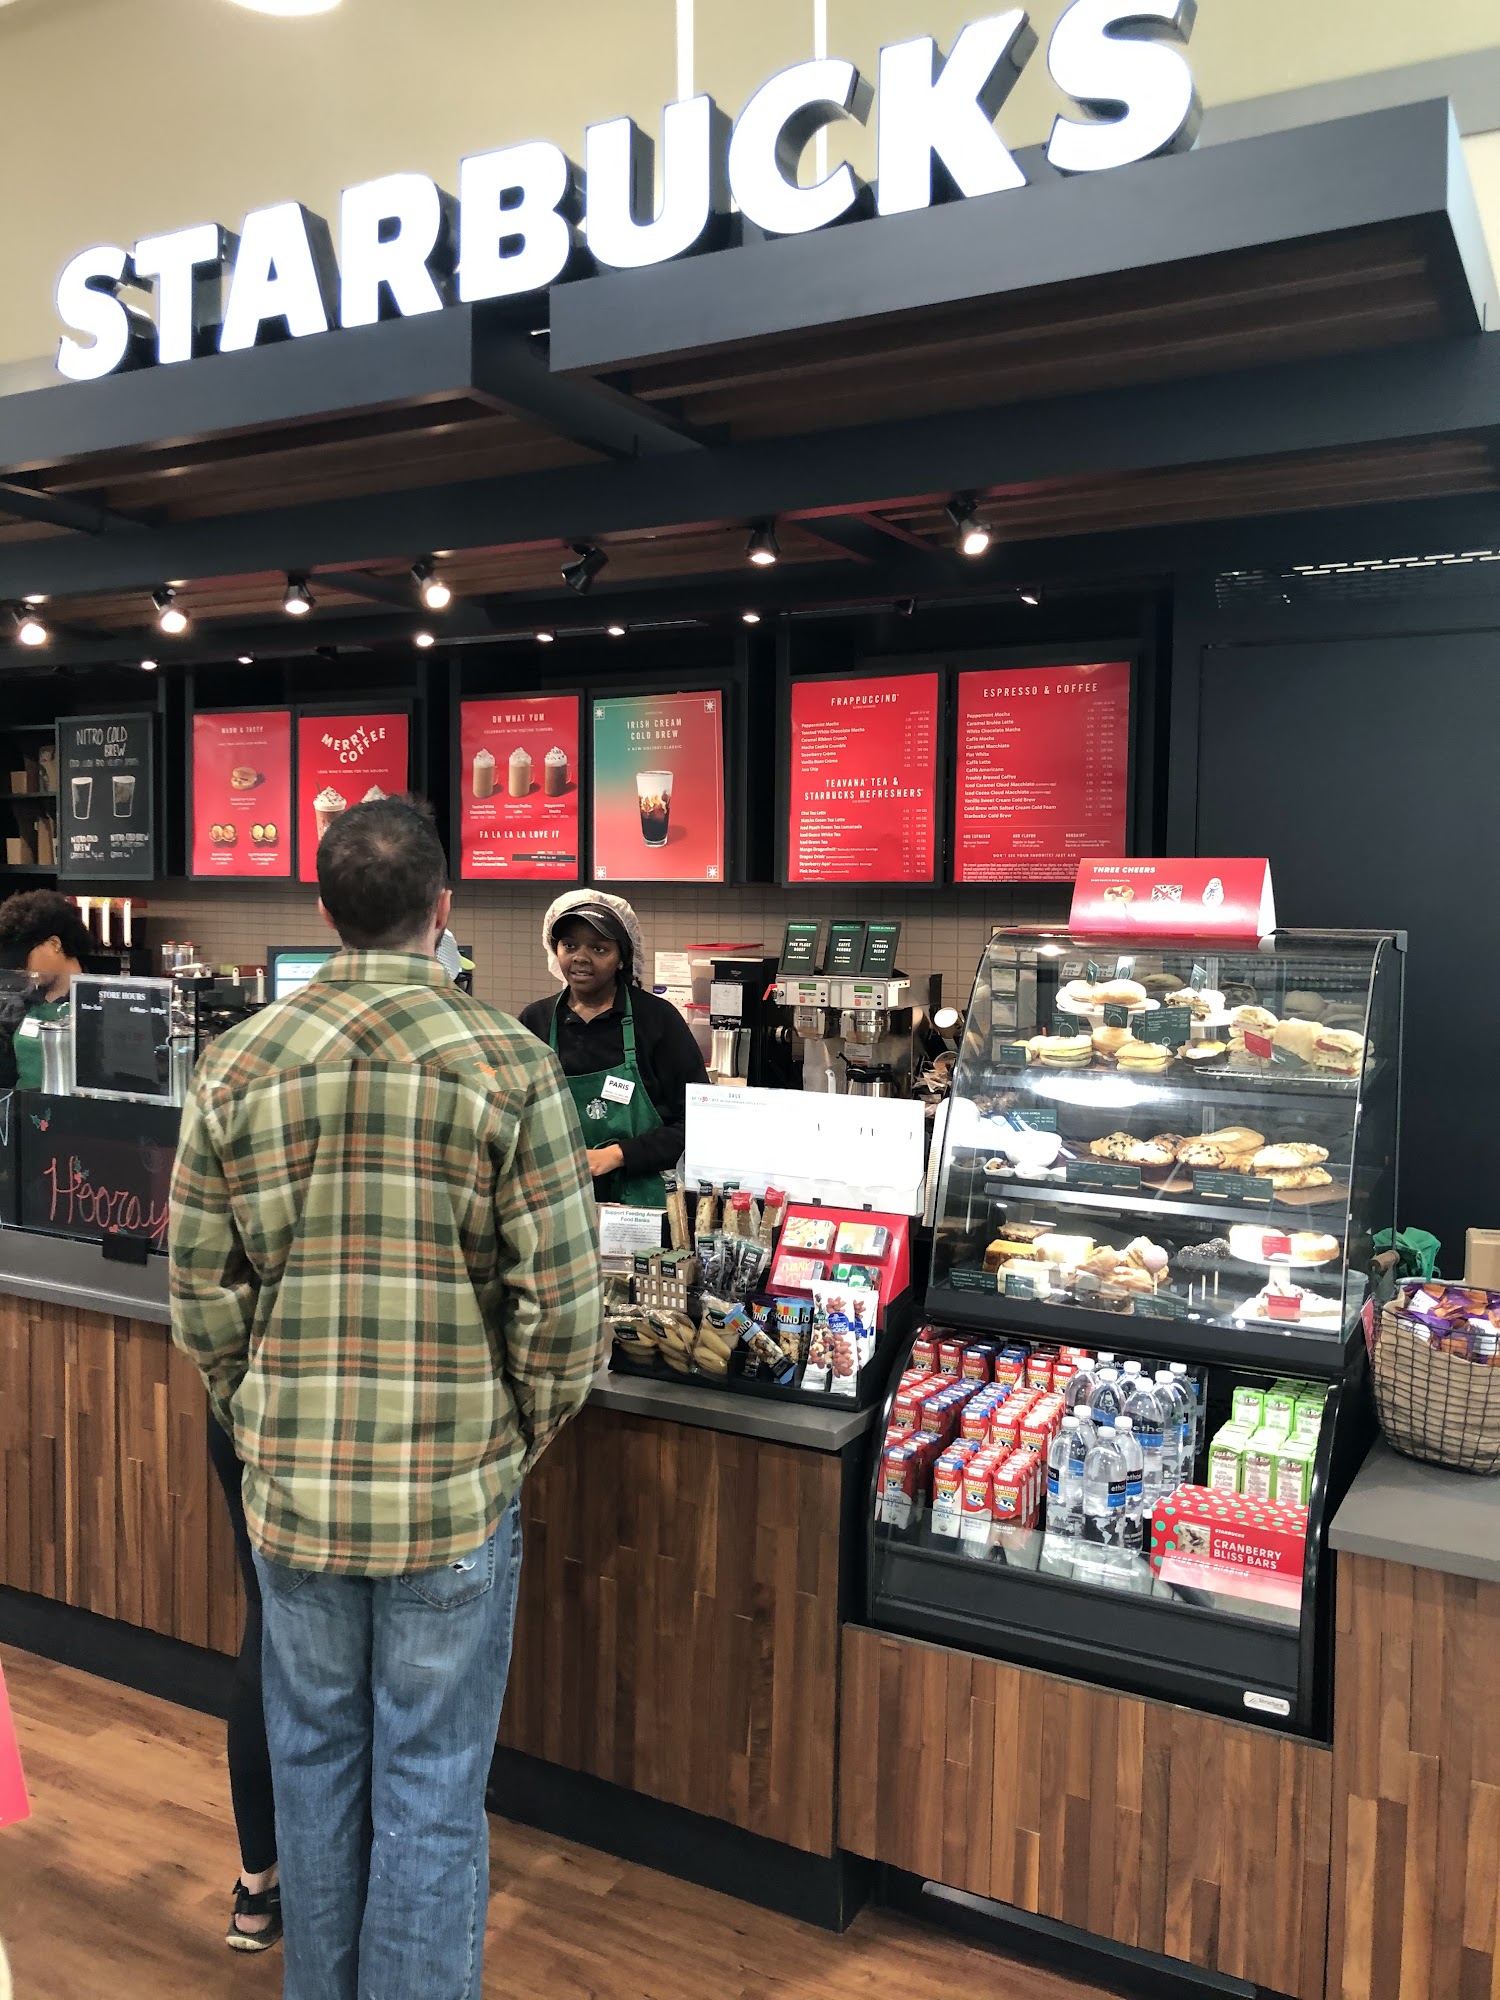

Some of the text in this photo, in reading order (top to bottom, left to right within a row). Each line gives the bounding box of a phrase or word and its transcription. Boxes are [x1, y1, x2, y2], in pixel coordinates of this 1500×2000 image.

[55, 0, 1193, 382] STARBUCKS
[984, 682, 1098, 698] ESPRESSO & COFFEE
[831, 694, 897, 706] FRAPPUCCINO
[506, 714, 525, 722] WHAT
[627, 718, 682, 729] IRISH CREAM
[76, 726, 128, 746] NITRO COLD
[321, 726, 366, 751] MERRY
[630, 730, 678, 740] COLD BREW
[104, 743, 126, 757] BREW
[340, 727, 386, 763] COFFEE
[871, 777, 888, 786] TEA
[893, 776, 898, 786] &
[804, 788, 922, 800] STARBUCKS REFRESHERS
[99, 991, 146, 1000] STORE HOURS
[609, 1080, 630, 1091] PARIS
[43, 1155, 169, 1249] Hooray
[778, 1313, 800, 1324] KIND
[996, 1370, 1018, 1378] HORIZON
[1028, 1369, 1051, 1378] HORIZON
[992, 1425, 1016, 1435] HORIZON
[1021, 1430, 1045, 1440] HORIZON
[935, 1477, 957, 1487] HORIZON
[964, 1478, 988, 1488] HORIZON
[994, 1483, 1019, 1493] HORIZON
[1215, 1529, 1245, 1538] STARBUCKS
[1214, 1539, 1282, 1560] CRANBERRY
[1214, 1548, 1277, 1570] BLISS BARS
[1170, 1555, 1250, 1577] MADE FOR SHARING
